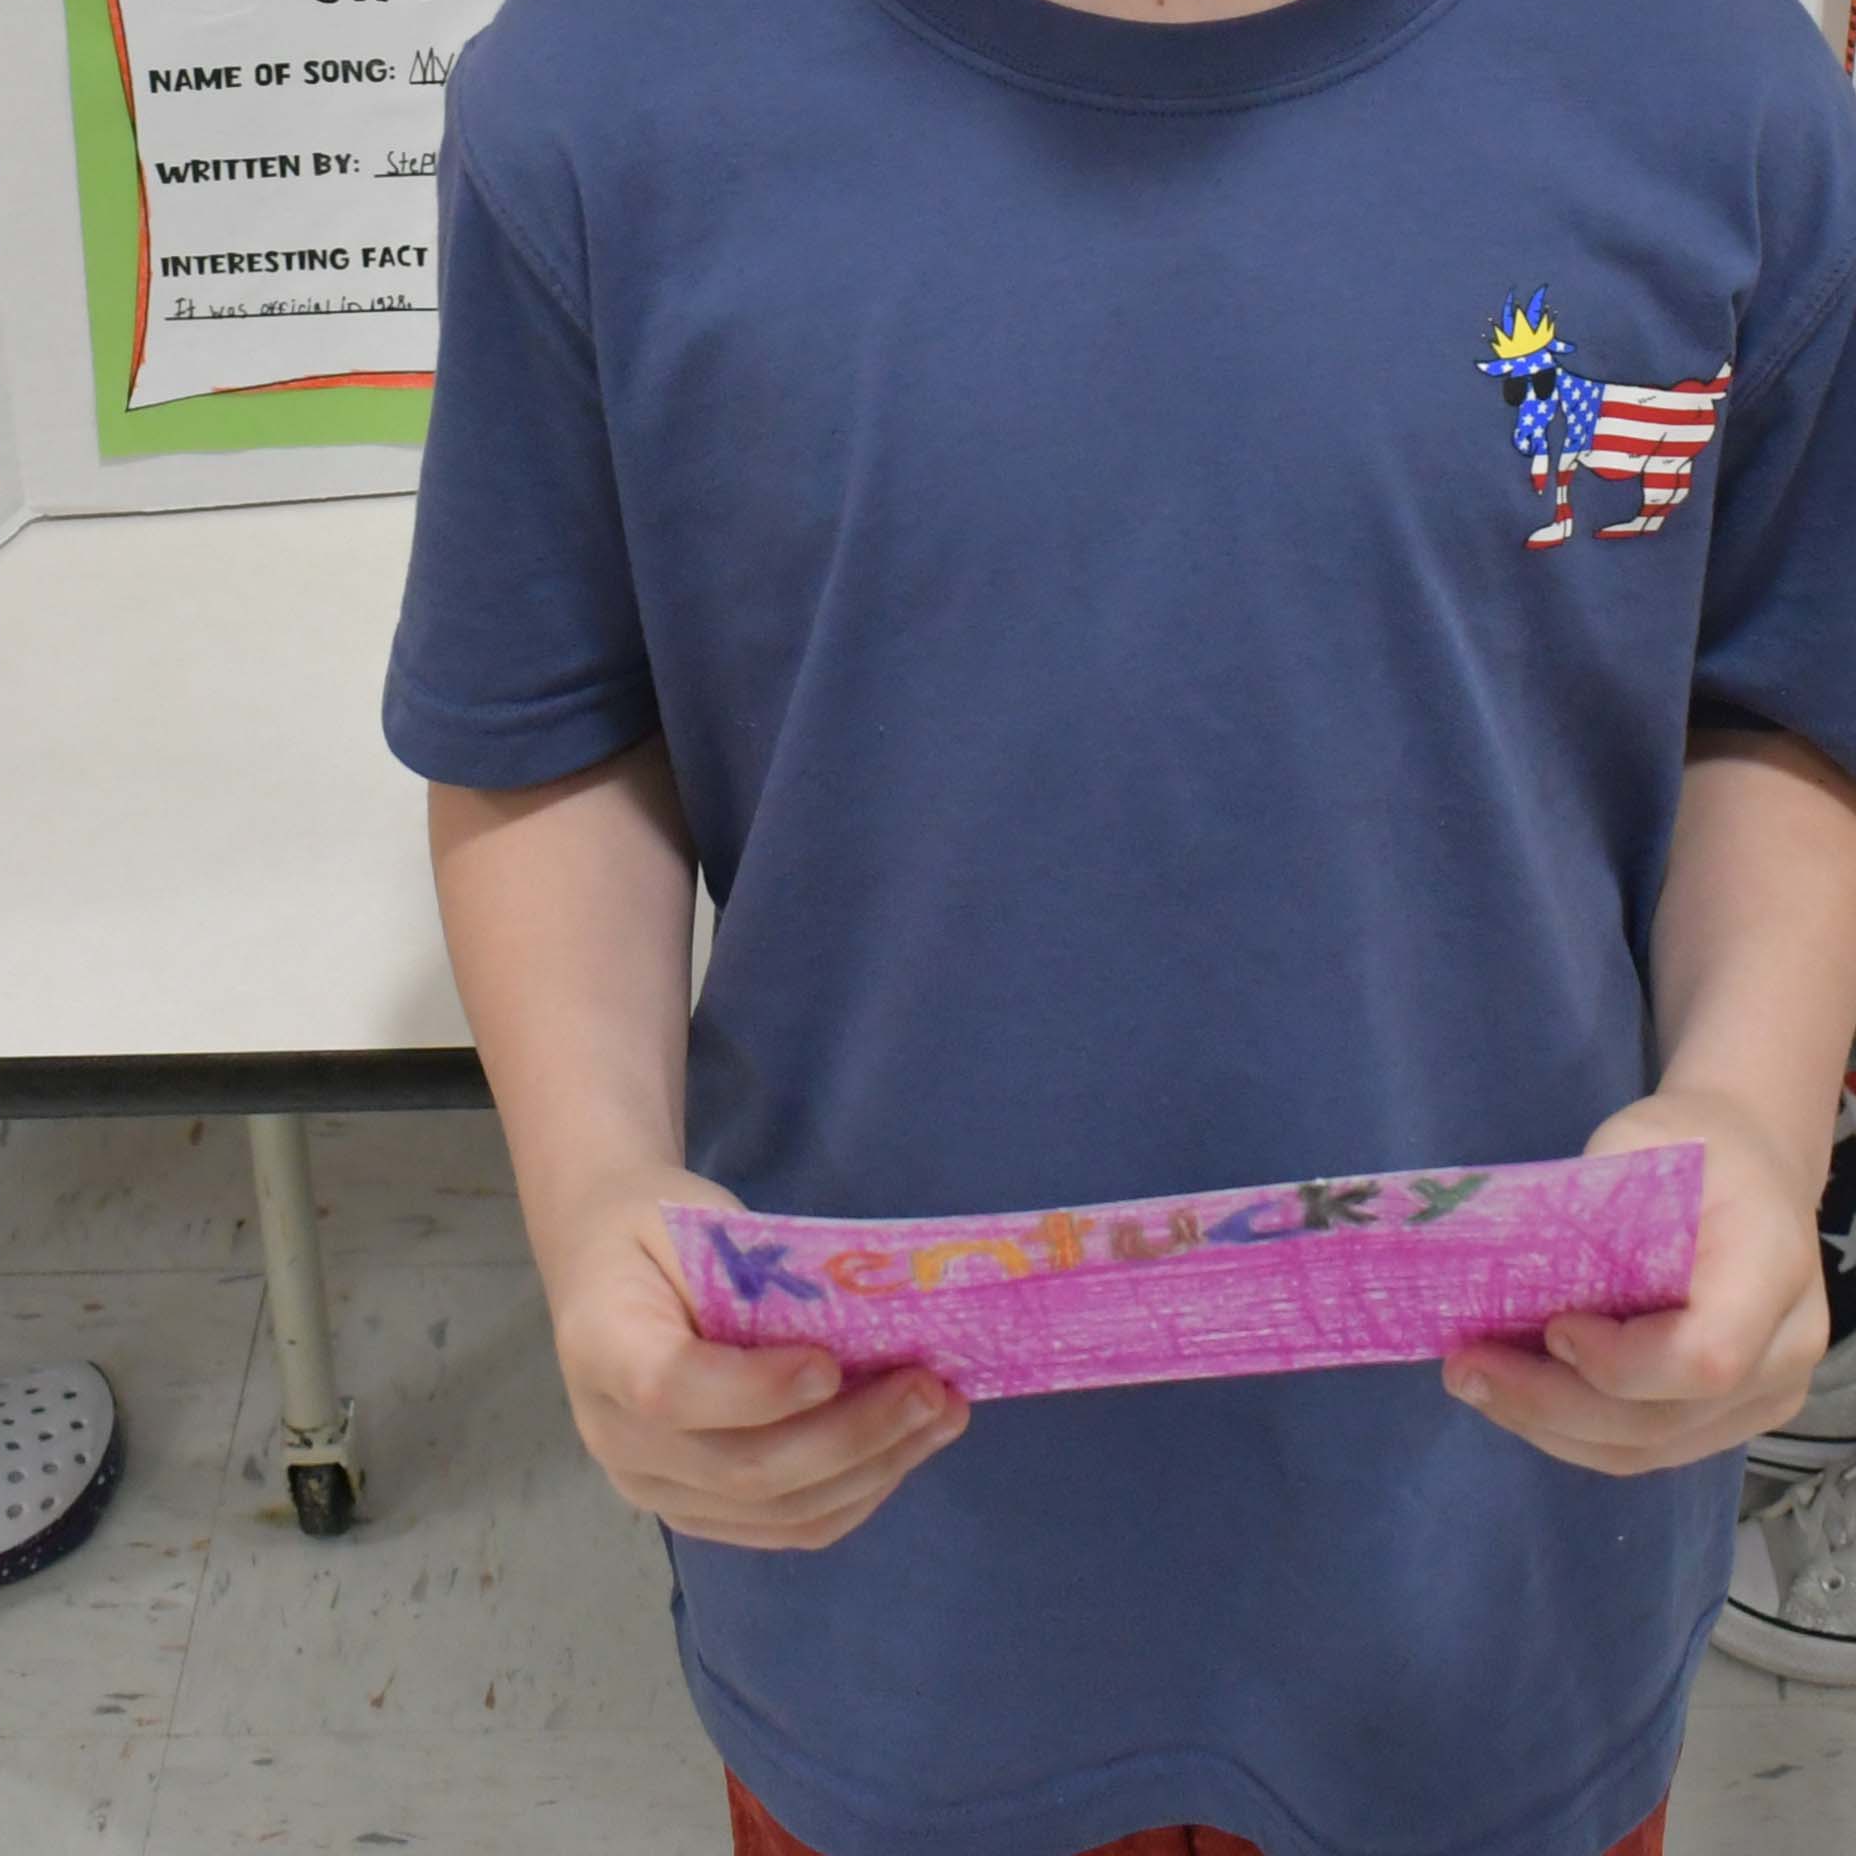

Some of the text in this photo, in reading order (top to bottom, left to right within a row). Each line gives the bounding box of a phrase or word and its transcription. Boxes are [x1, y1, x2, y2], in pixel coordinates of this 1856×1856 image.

[149, 59, 396, 93] NAME OF SONG:
[155, 151, 360, 184] WRITTEN BY:
[160, 244, 429, 278] INTERESTING FACT
[175, 297, 196, 319] It
[208, 302, 248, 318] was
[259, 296, 331, 315] official
[340, 295, 363, 313] in
